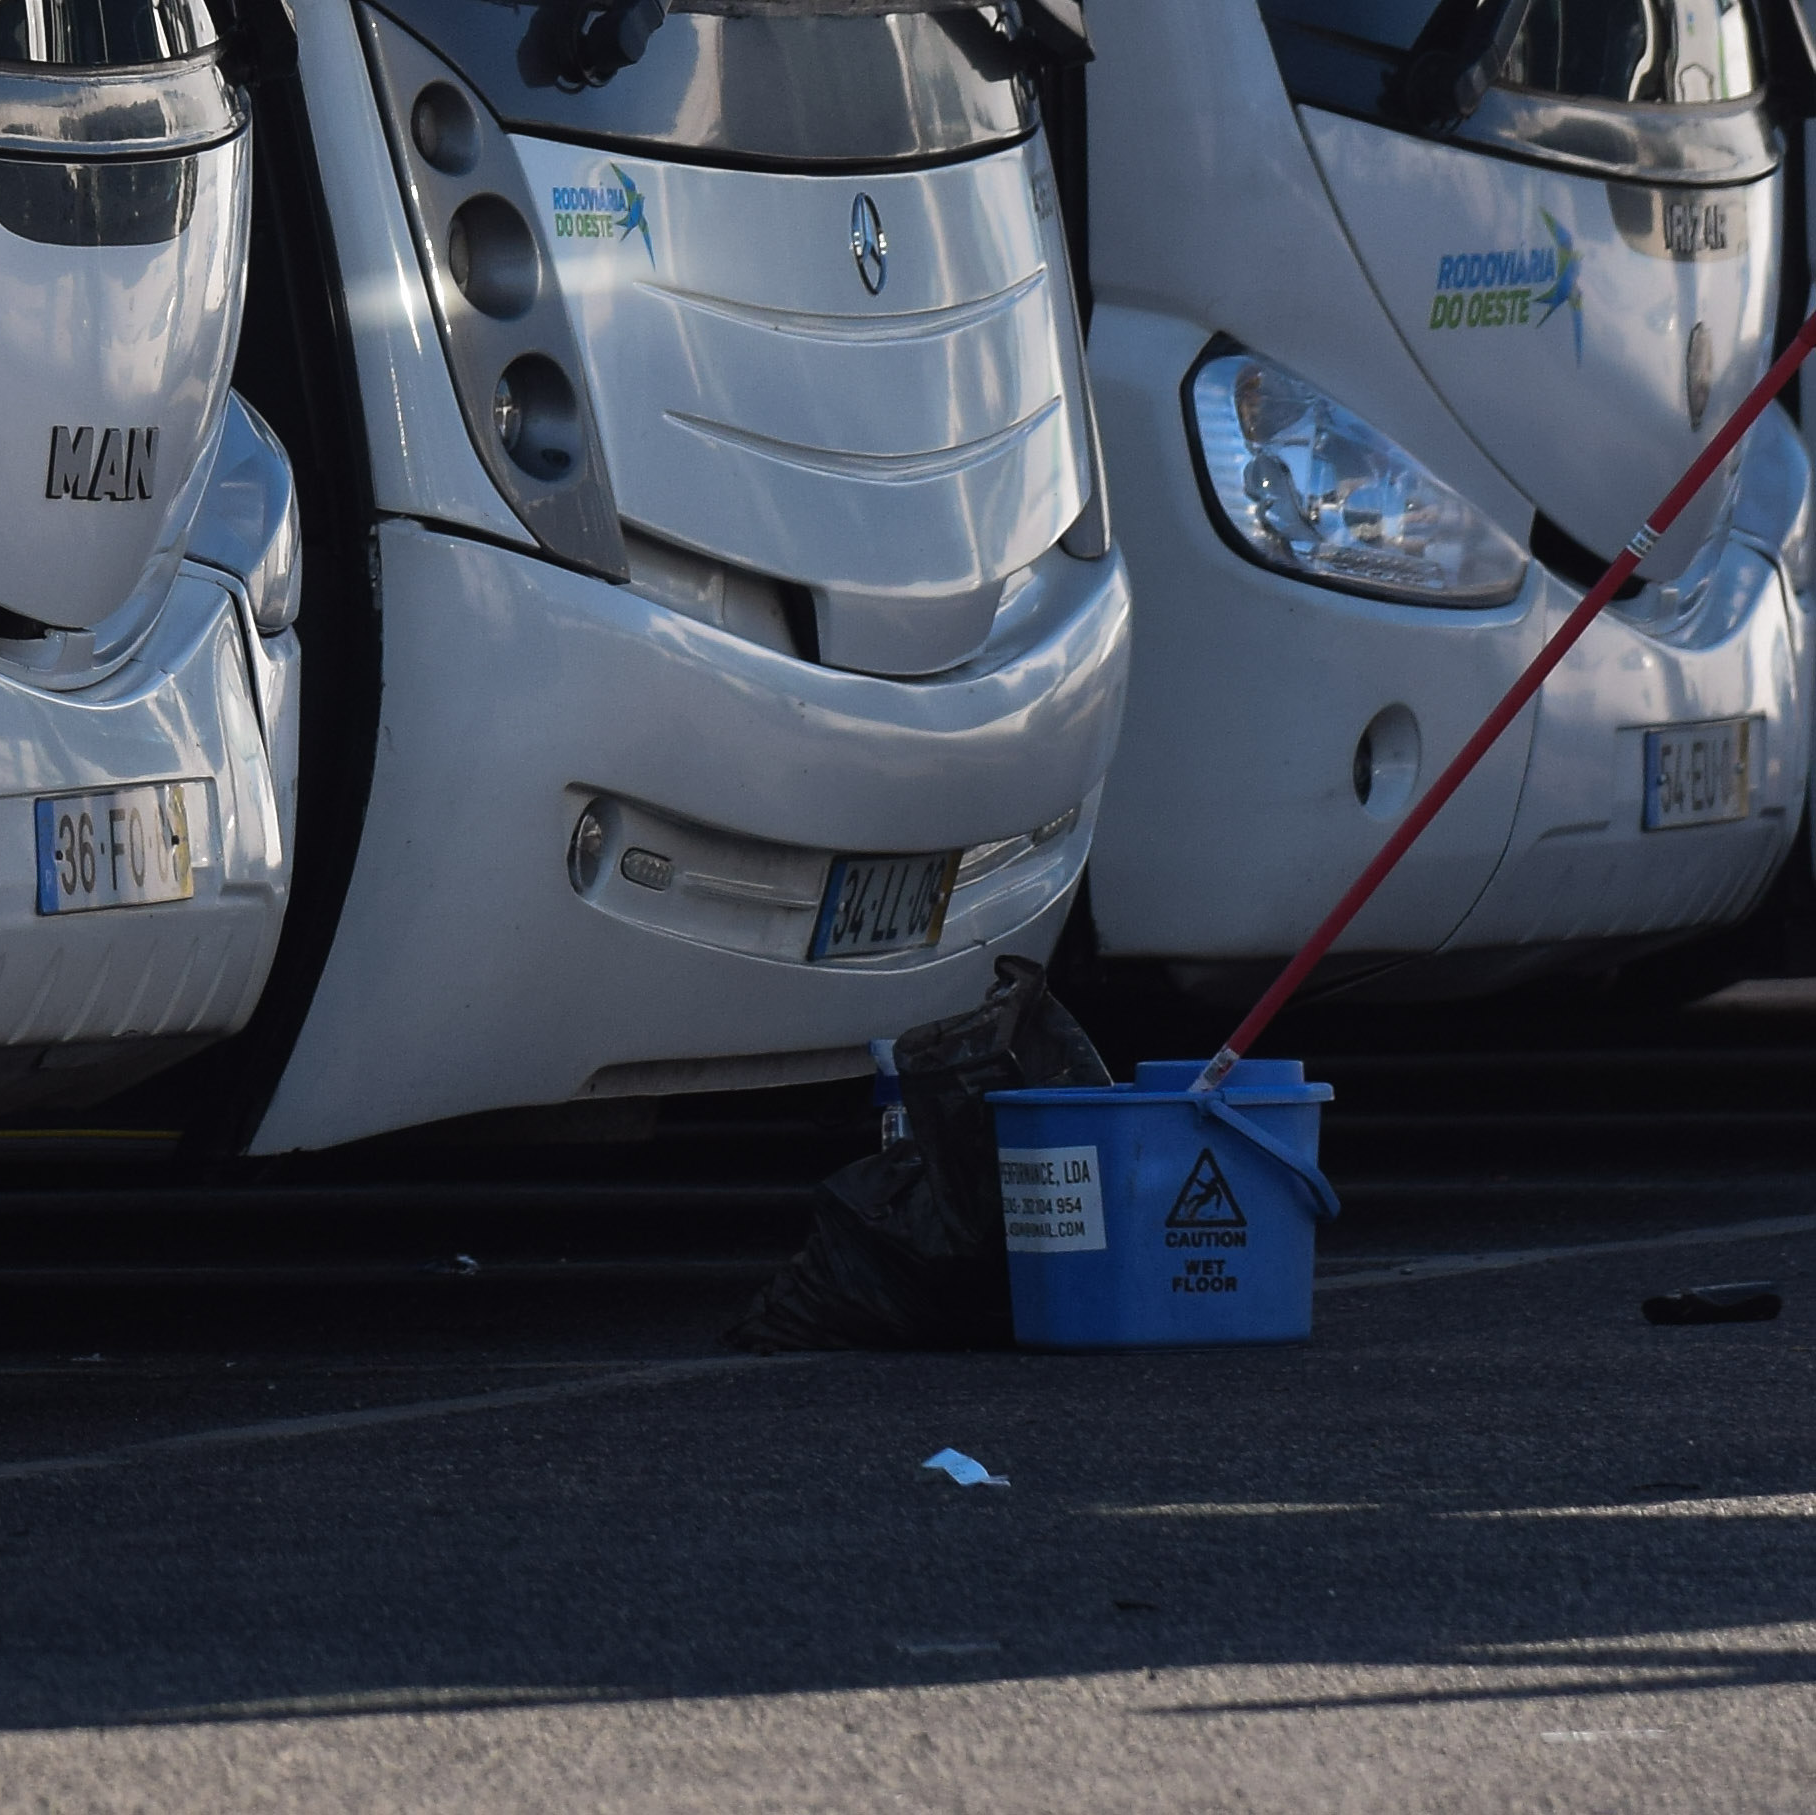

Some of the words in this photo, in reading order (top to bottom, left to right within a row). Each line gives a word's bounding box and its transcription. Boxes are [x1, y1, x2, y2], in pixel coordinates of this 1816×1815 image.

[555, 213, 574, 237] DO
[576, 213, 614, 238] OESTE
[1429, 293, 1464, 330] DO
[1466, 288, 1532, 328] OESTE
[45, 425, 159, 501] MAN
[1064, 1159, 1091, 1184] LDA
[1056, 1197, 1082, 1214] 954
[1165, 1230, 1246, 1248] CAUTION
[1185, 1259, 1226, 1276] WET
[1172, 1276, 1238, 1293] FLOOR
